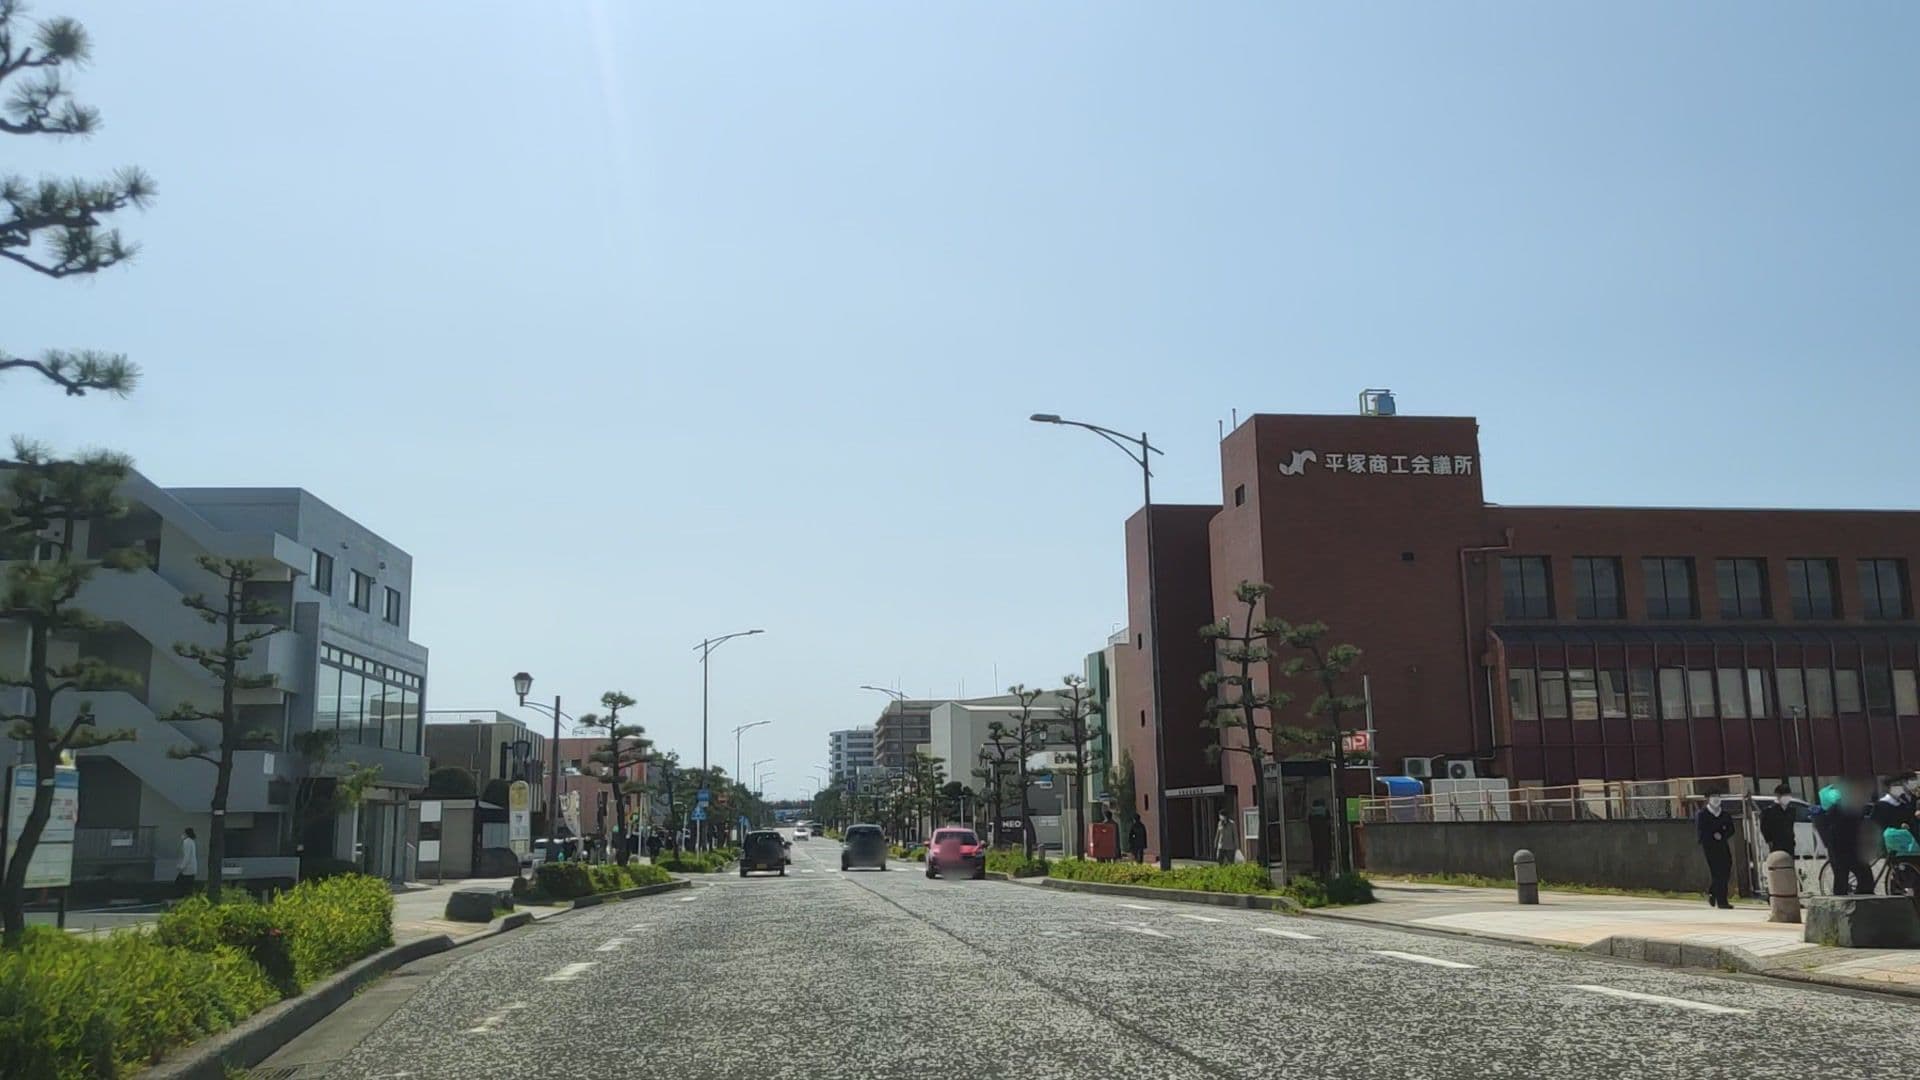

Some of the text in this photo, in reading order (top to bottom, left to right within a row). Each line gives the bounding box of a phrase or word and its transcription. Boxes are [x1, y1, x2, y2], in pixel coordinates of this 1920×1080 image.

[1325, 453, 1473, 475] 平塚商工会議所
[1352, 735, 1366, 751] P
